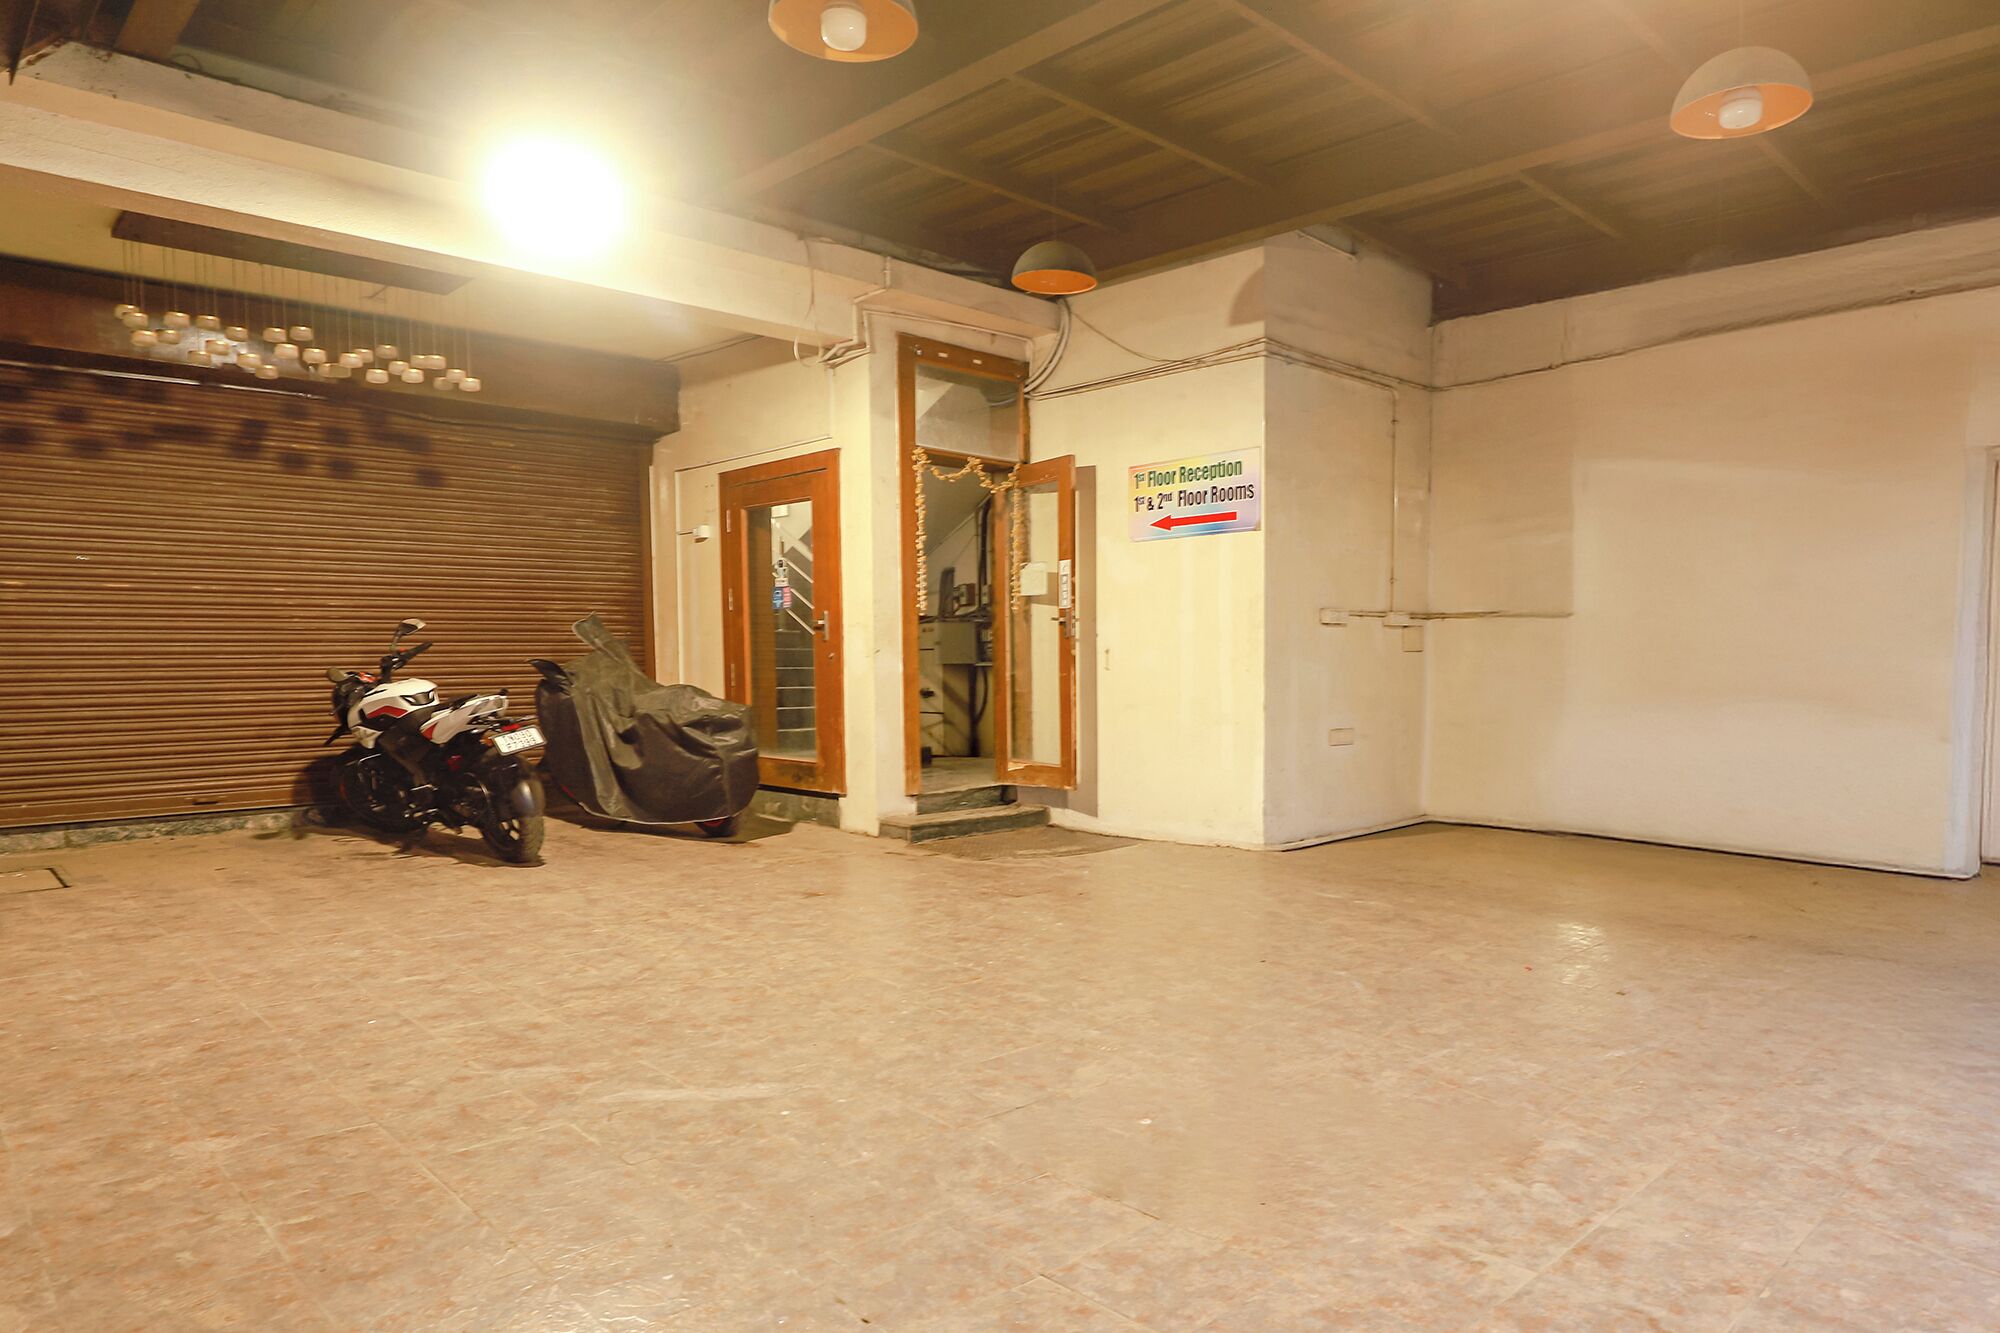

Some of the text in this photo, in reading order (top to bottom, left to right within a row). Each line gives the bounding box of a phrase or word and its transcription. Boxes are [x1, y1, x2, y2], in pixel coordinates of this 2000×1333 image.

[1148, 470, 1177, 488] Floor
[1179, 460, 1242, 483] Reception
[1147, 496, 1154, 510] &
[1178, 489, 1208, 507] Floor
[1210, 484, 1255, 504] Rooms
